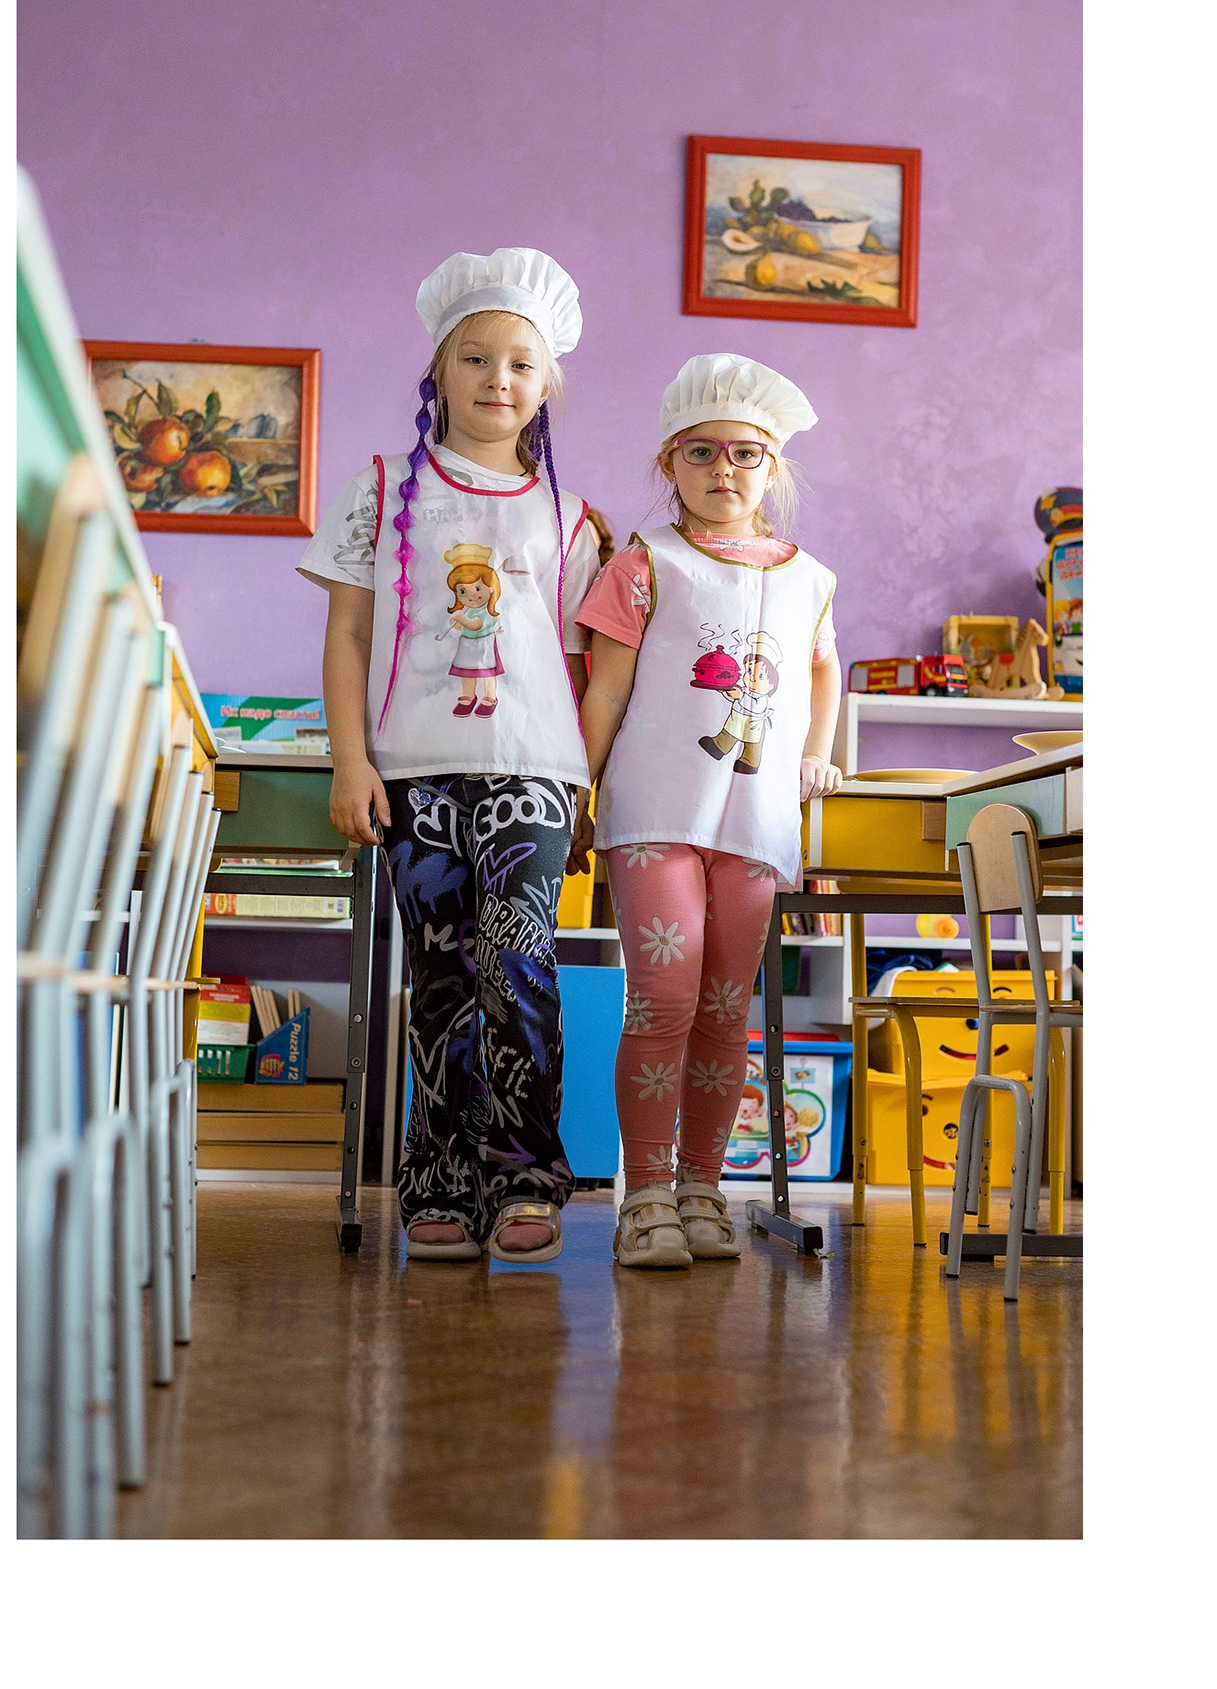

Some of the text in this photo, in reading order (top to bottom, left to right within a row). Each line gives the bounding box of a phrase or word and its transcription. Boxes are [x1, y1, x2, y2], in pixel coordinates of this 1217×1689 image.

[473, 781, 565, 842] GOOD
[288, 1022, 302, 1081] Puzzle 12
